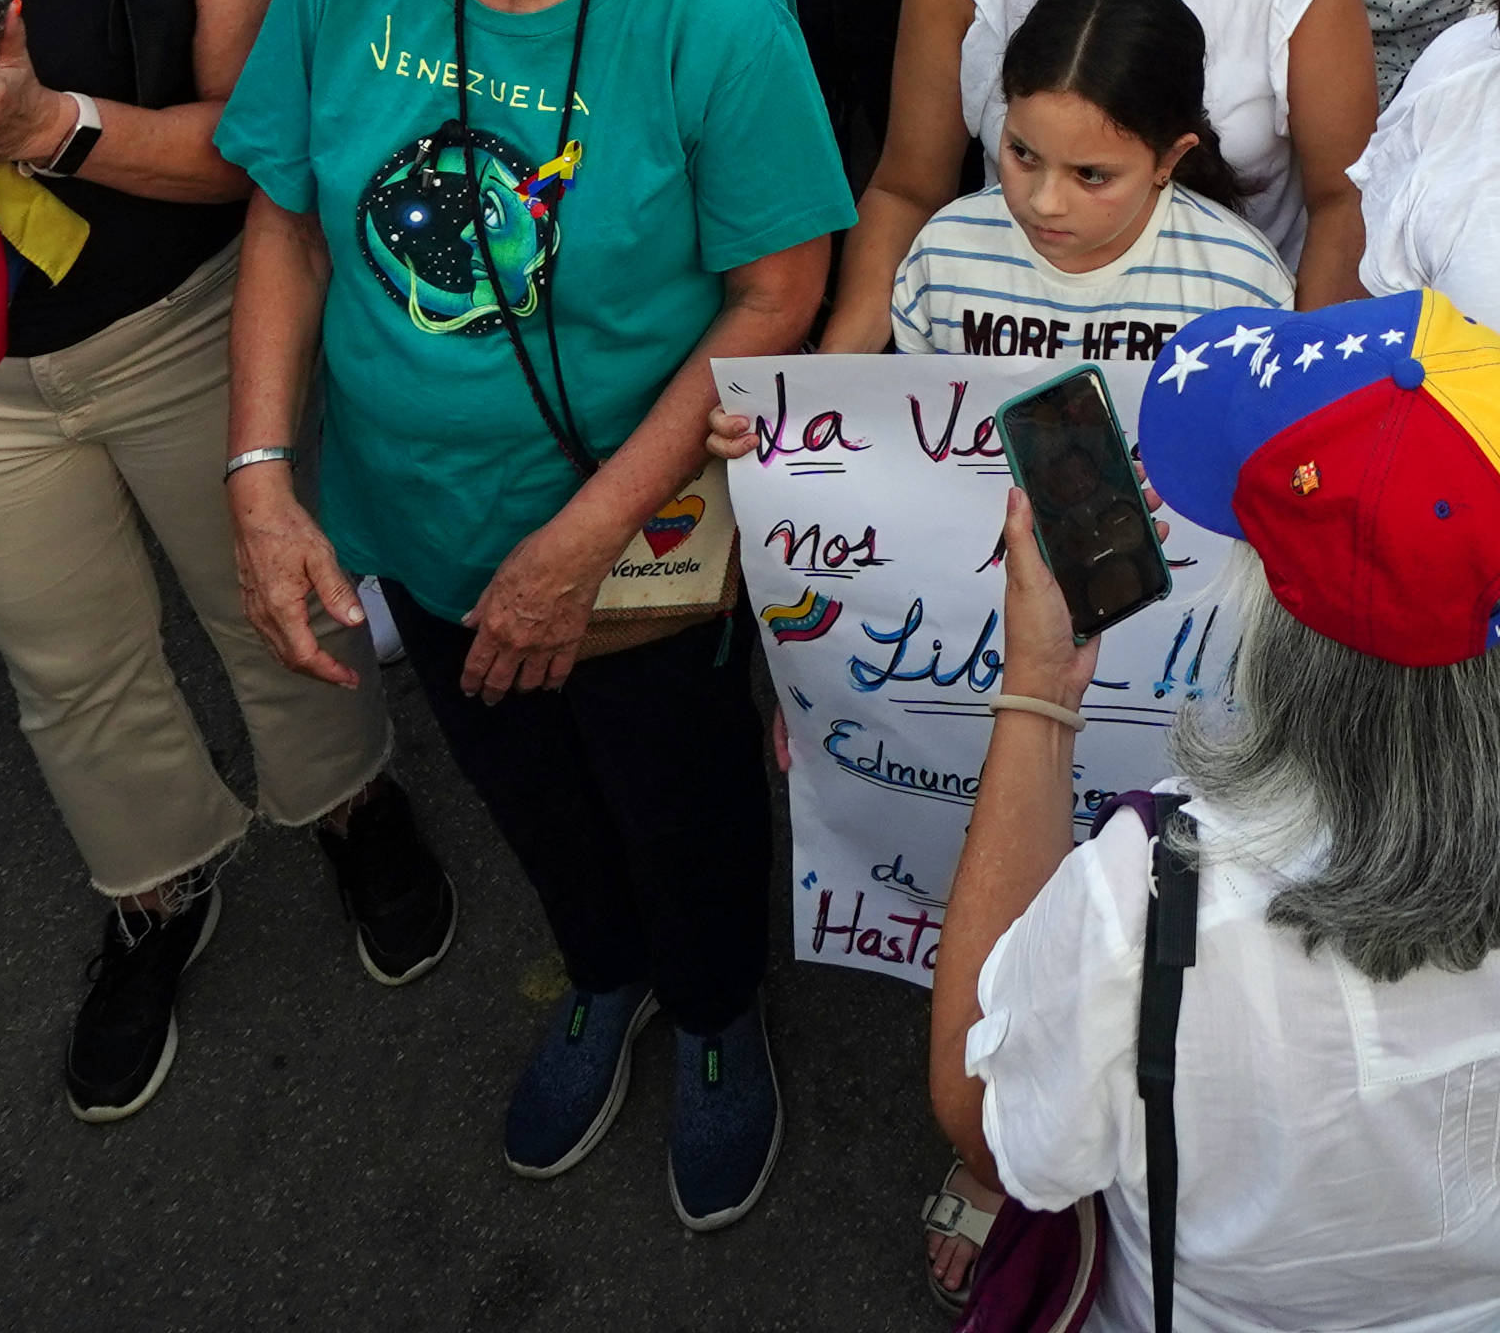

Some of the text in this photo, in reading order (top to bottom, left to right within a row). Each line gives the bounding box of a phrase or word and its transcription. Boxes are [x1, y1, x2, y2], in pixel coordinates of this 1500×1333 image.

[370, 14, 590, 116] VENEZUELA
[962, 308, 1070, 359] MORE
[611, 557, 702, 578] Venezuela
